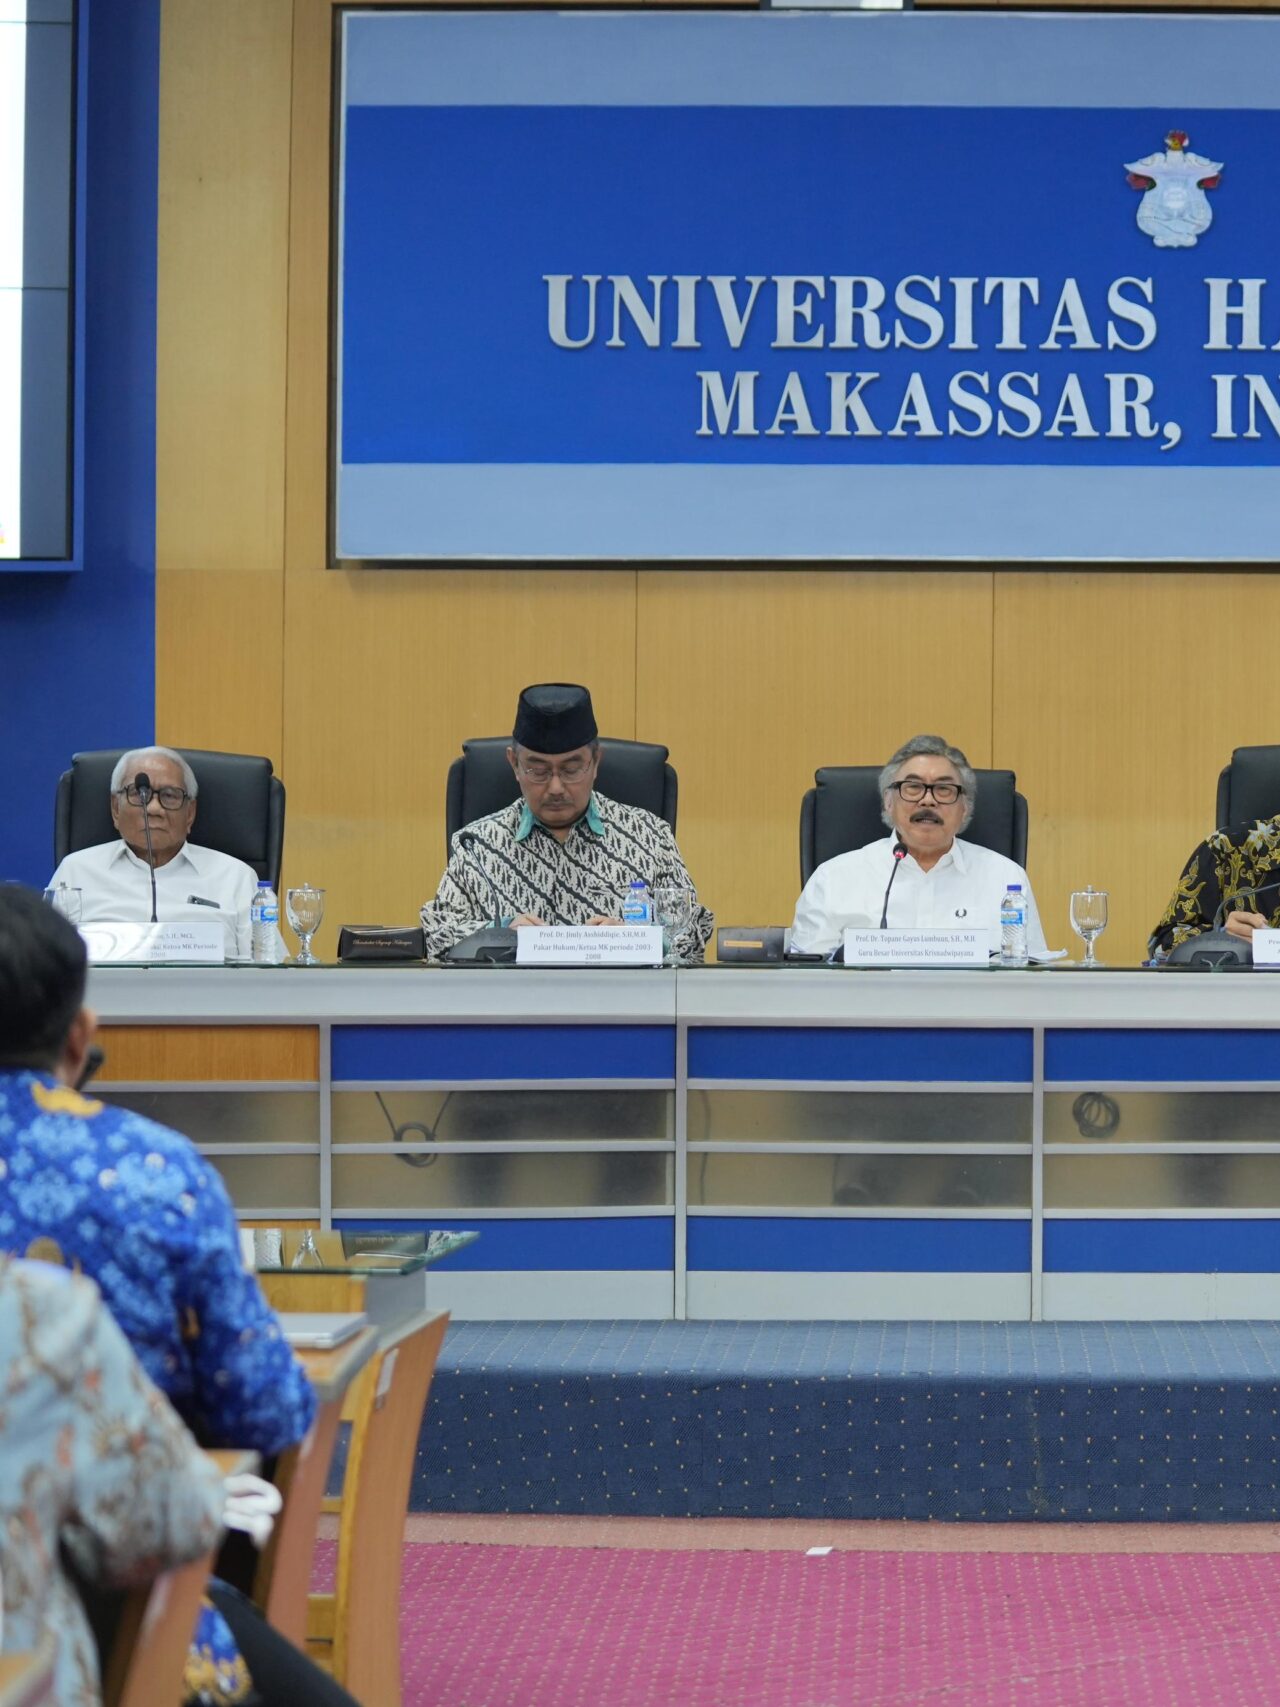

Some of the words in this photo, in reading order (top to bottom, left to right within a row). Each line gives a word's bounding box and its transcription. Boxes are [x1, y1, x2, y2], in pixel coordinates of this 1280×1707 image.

[548, 275, 1156, 350] UNIVERSITAS
[697, 372, 1181, 449] MAKASSAR,
[566, 931, 581, 940] Jimly
[856, 935, 869, 943] Prof.
[610, 944, 634, 952] periode
[874, 949, 890, 957] Besar
[891, 949, 923, 957] Universitas
